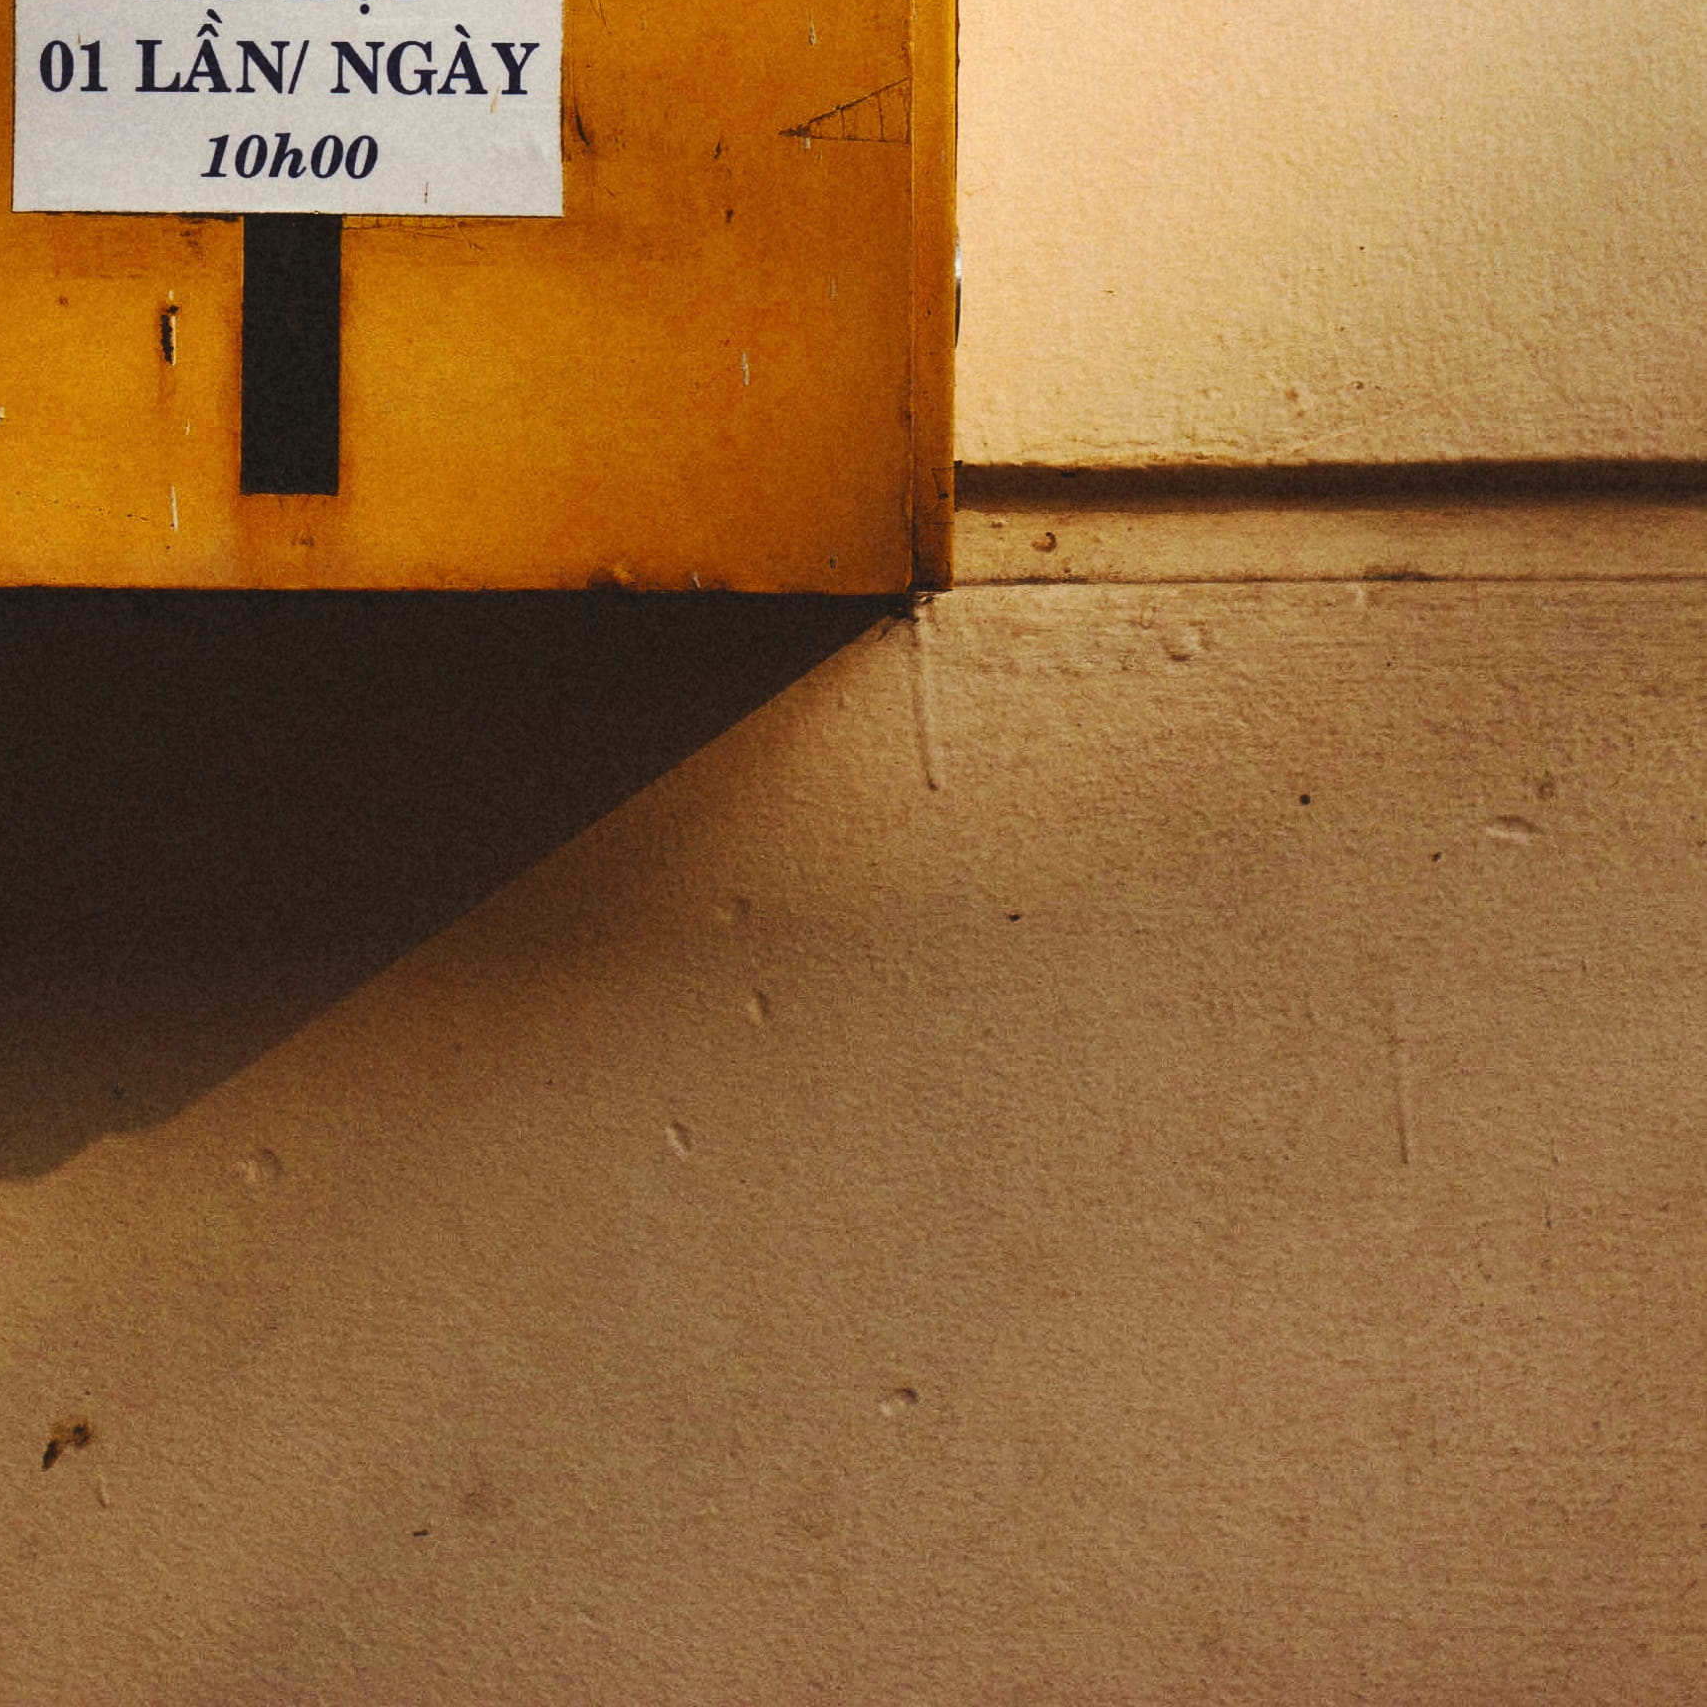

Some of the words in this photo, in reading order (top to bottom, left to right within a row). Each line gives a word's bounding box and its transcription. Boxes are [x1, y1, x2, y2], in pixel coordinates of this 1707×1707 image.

[39, 39, 109, 93] 01
[134, 8, 310, 95] LẦN/
[330, 23, 541, 96] NGÀY
[200, 132, 380, 180] 10h00
